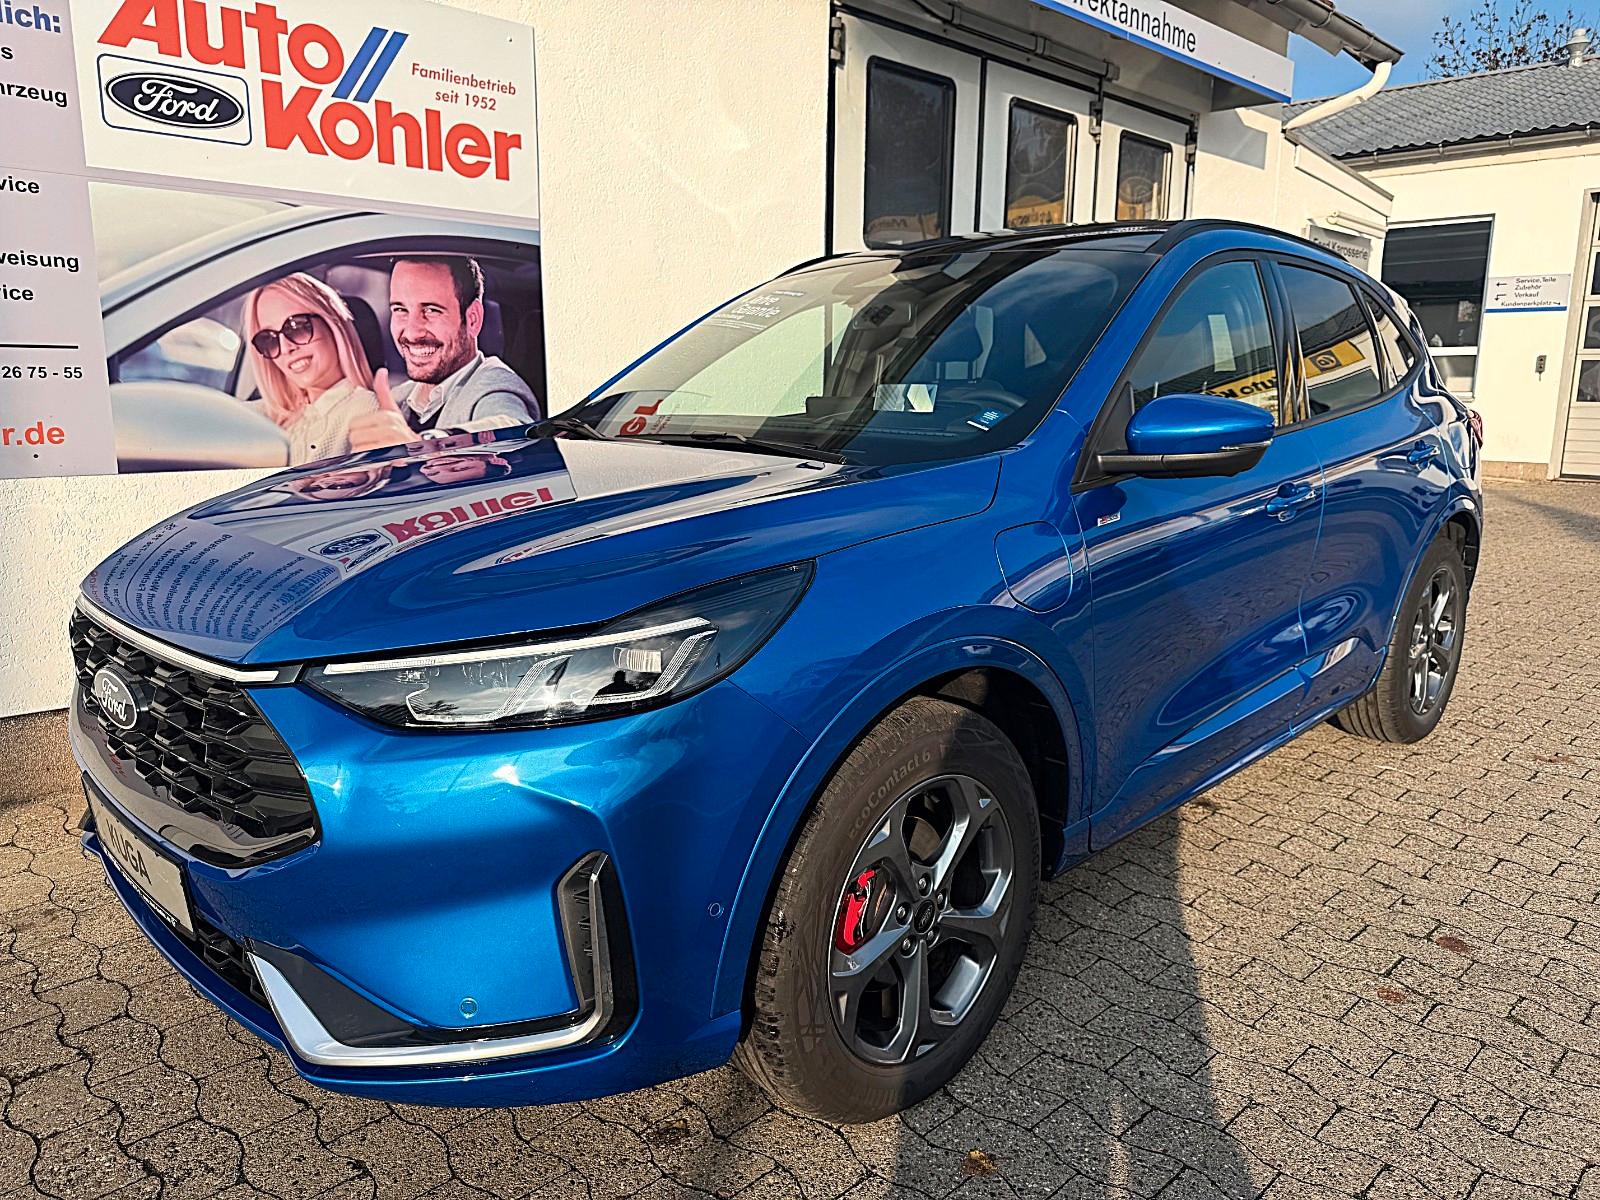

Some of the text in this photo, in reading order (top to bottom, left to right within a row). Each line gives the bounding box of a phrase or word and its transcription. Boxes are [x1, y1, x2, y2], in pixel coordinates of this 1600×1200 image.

[97, 0, 345, 84] Auto
[1072, 0, 1197, 53] ektannahme
[411, 62, 517, 95] Familienbetrieb
[133, 79, 220, 122] Ford
[435, 90, 497, 111] seit 1952
[0, 283, 35, 301] ice
[1, 365, 23, 379] 26
[27, 366, 48, 379] 75
[63, 366, 83, 379] 55
[105, 818, 153, 887] KUGA
